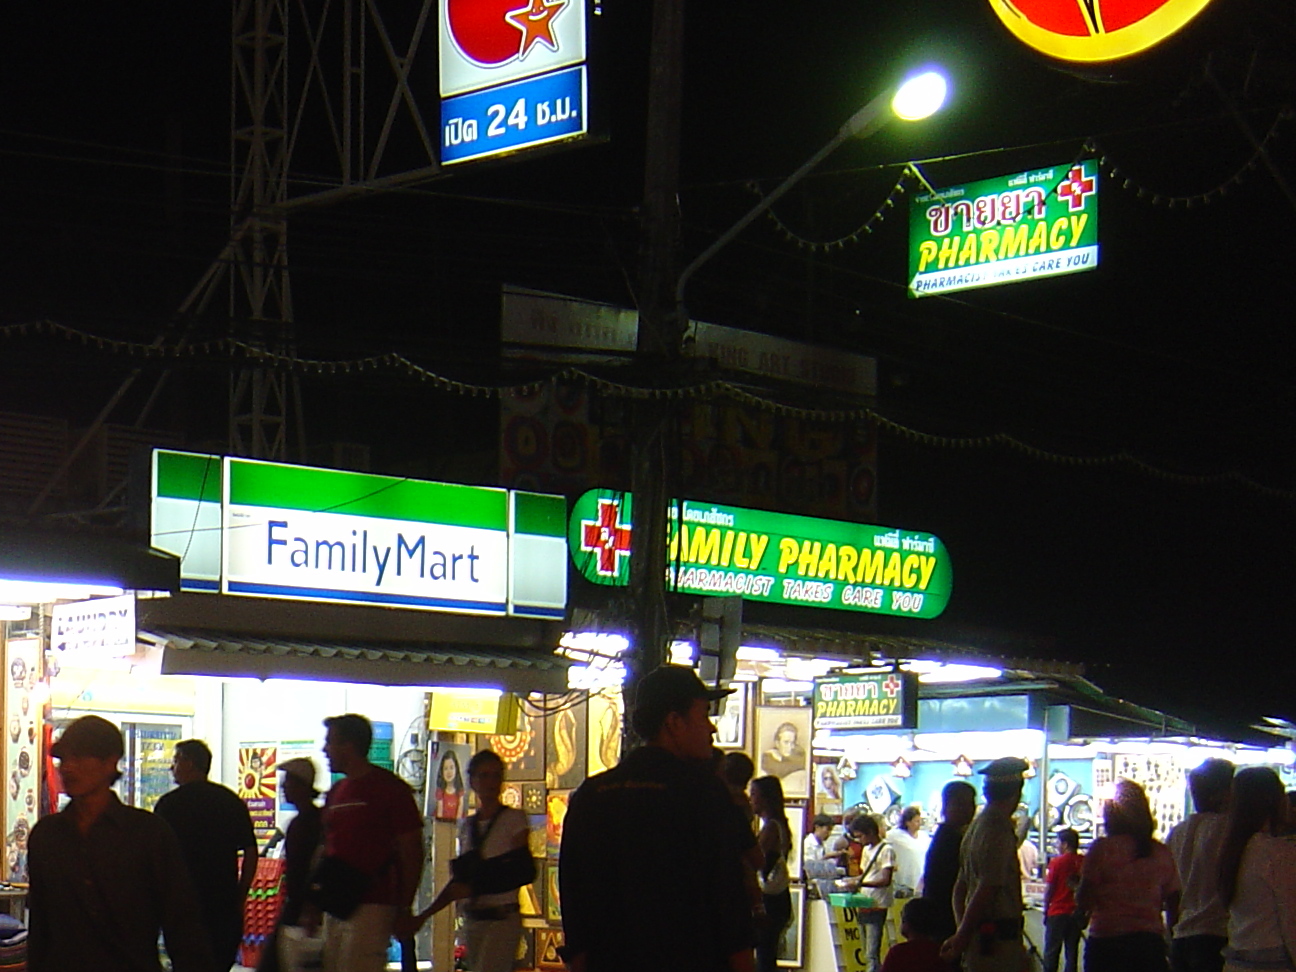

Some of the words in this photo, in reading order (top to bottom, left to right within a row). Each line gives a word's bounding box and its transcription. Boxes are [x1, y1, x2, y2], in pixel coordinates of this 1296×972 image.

[486, 98, 527, 137] 24
[926, 186, 1046, 237] ขายยา
[918, 213, 1089, 273] PHARMACY
[916, 271, 987, 292] PHARMACIST
[1032, 257, 1062, 273] CARE
[1066, 252, 1091, 268] YOU
[266, 520, 480, 587] FamilyMart
[669, 525, 769, 572] AMILY
[778, 537, 937, 591] PHARMACY
[782, 579, 834, 603] TAKES
[842, 585, 883, 608] CARE
[891, 592, 925, 614] YOU
[57, 608, 128, 635] LAUNDRY
[816, 699, 897, 717] PHARMACY
